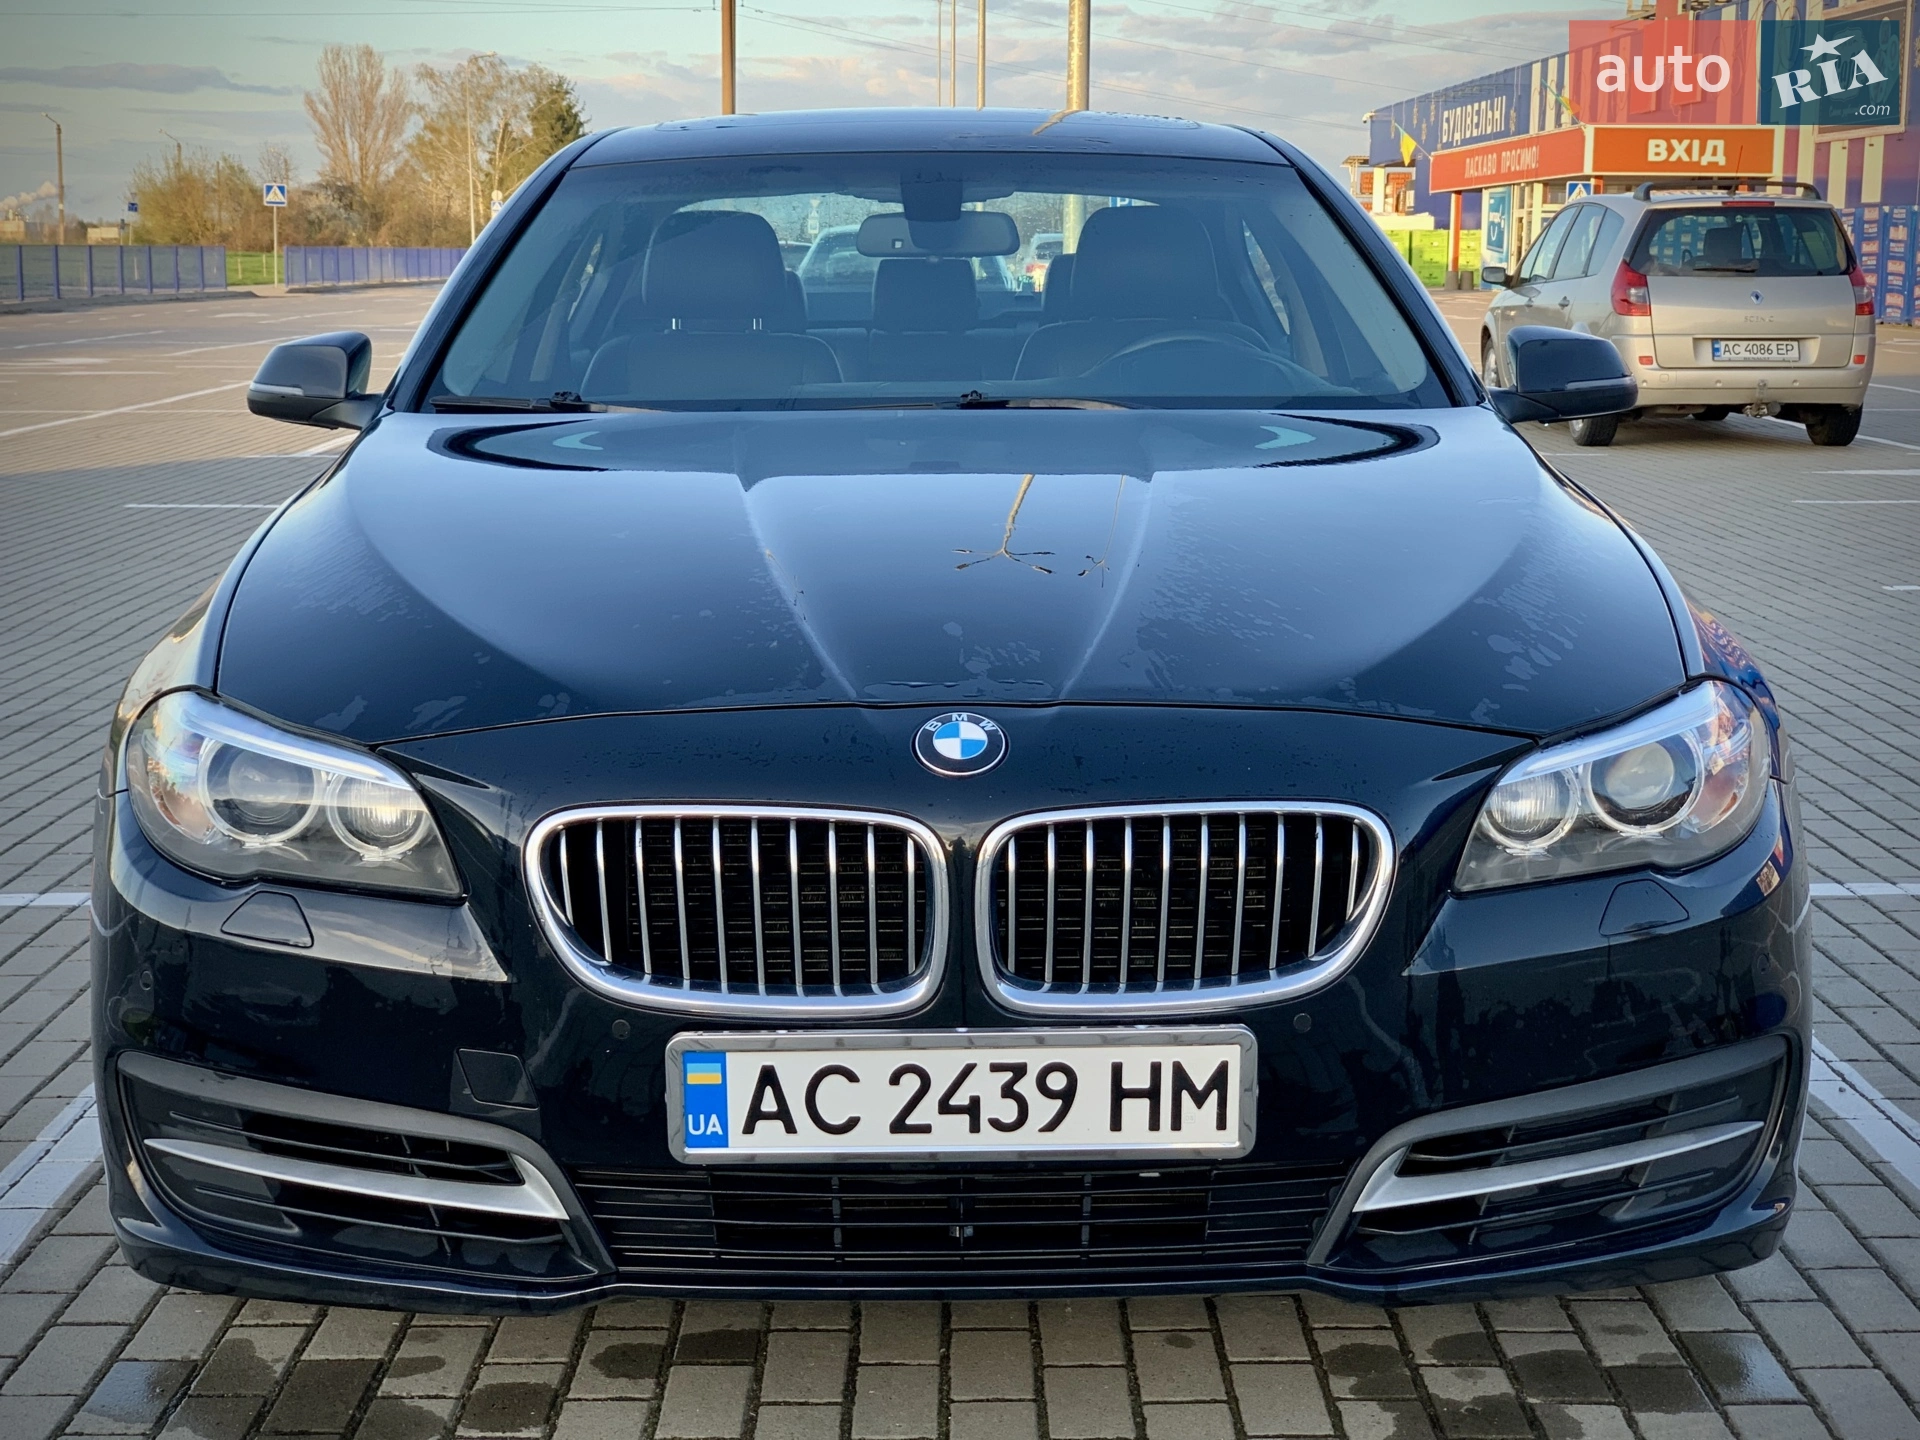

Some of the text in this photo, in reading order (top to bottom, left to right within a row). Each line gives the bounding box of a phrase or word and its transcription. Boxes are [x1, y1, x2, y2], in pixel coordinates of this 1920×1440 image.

[1442, 95, 1506, 146] БУДІВЕЛЬНІ
[1465, 145, 1540, 179] ЛАСКАВО ПРОСИМО!
[1647, 138, 1727, 166] ВХІД
[1723, 343, 1741, 355] AC
[1744, 343, 1773, 355] 4086
[1776, 343, 1794, 355] EP
[924, 713, 997, 732] BMW
[741, 1060, 1229, 1136] AC 2439 HM
[688, 1113, 724, 1137] UA
